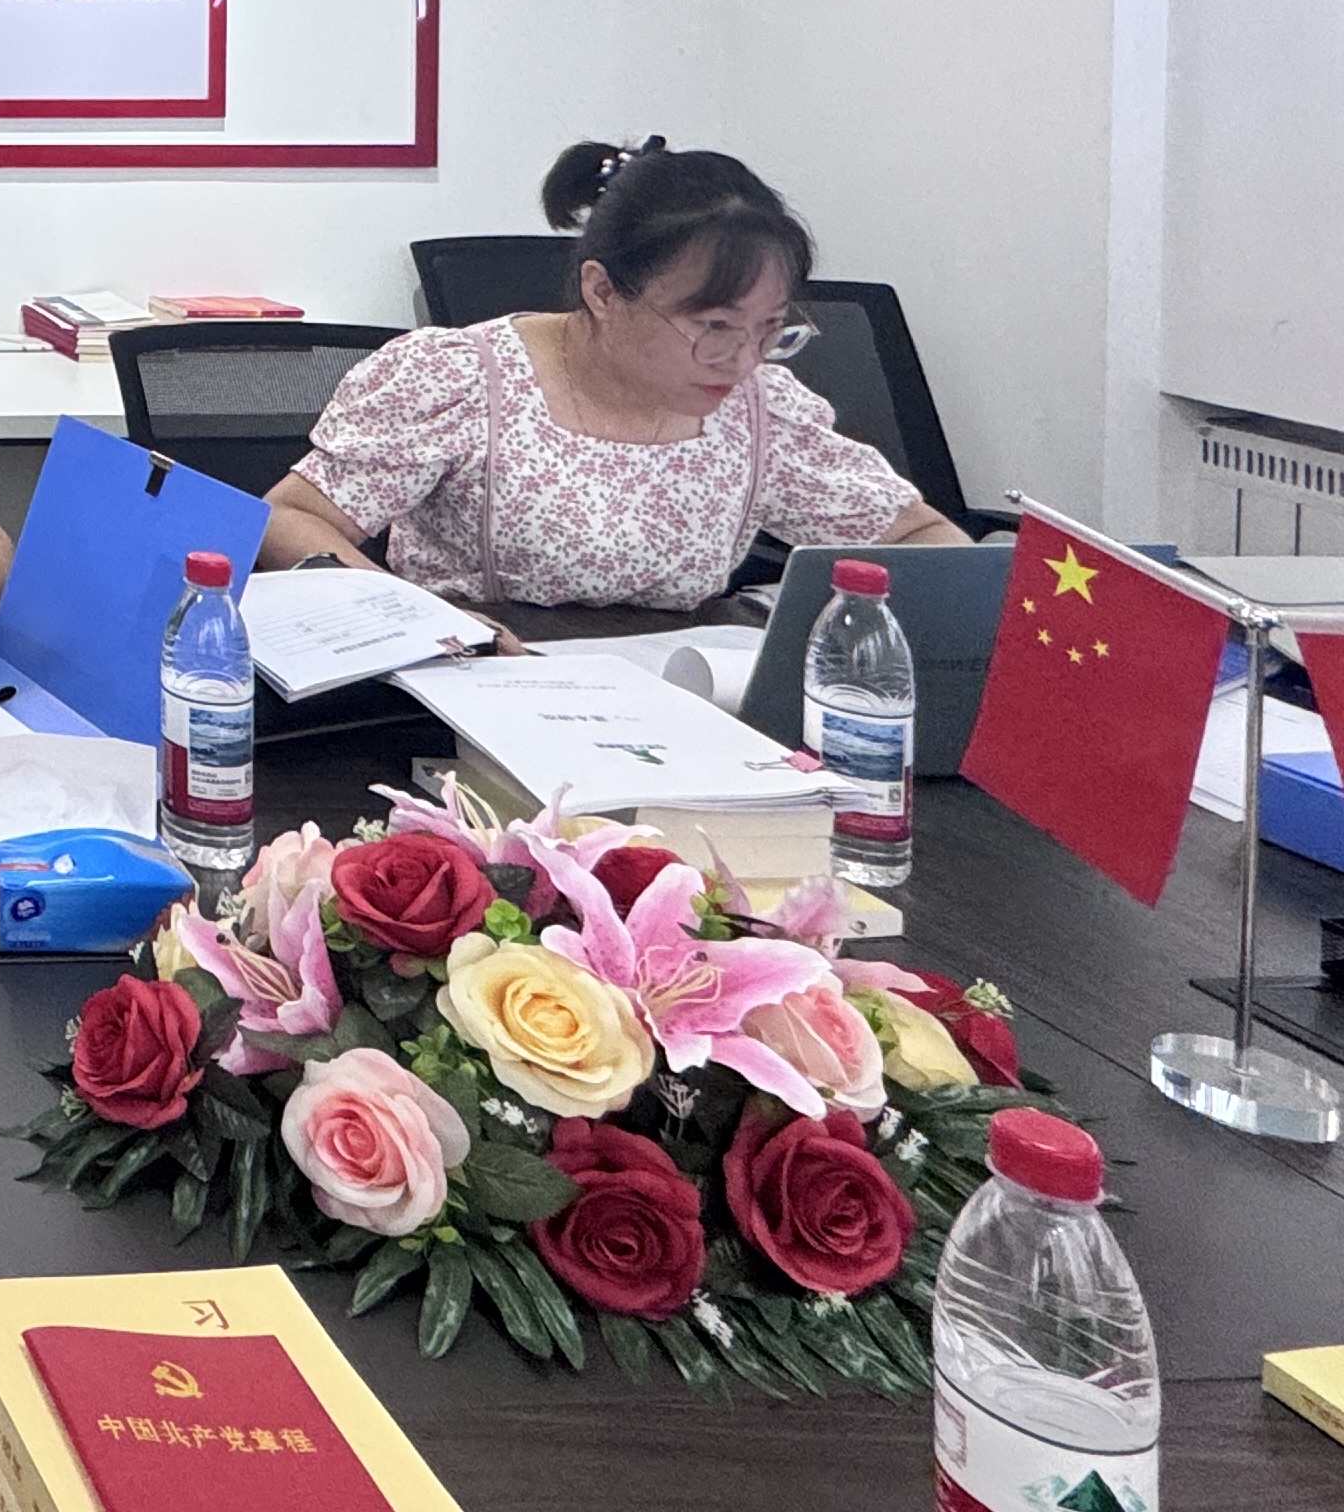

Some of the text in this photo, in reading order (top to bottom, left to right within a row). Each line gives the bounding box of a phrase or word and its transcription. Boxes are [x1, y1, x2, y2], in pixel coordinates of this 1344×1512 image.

[97, 1414, 317, 1454] 中国共产党章程
